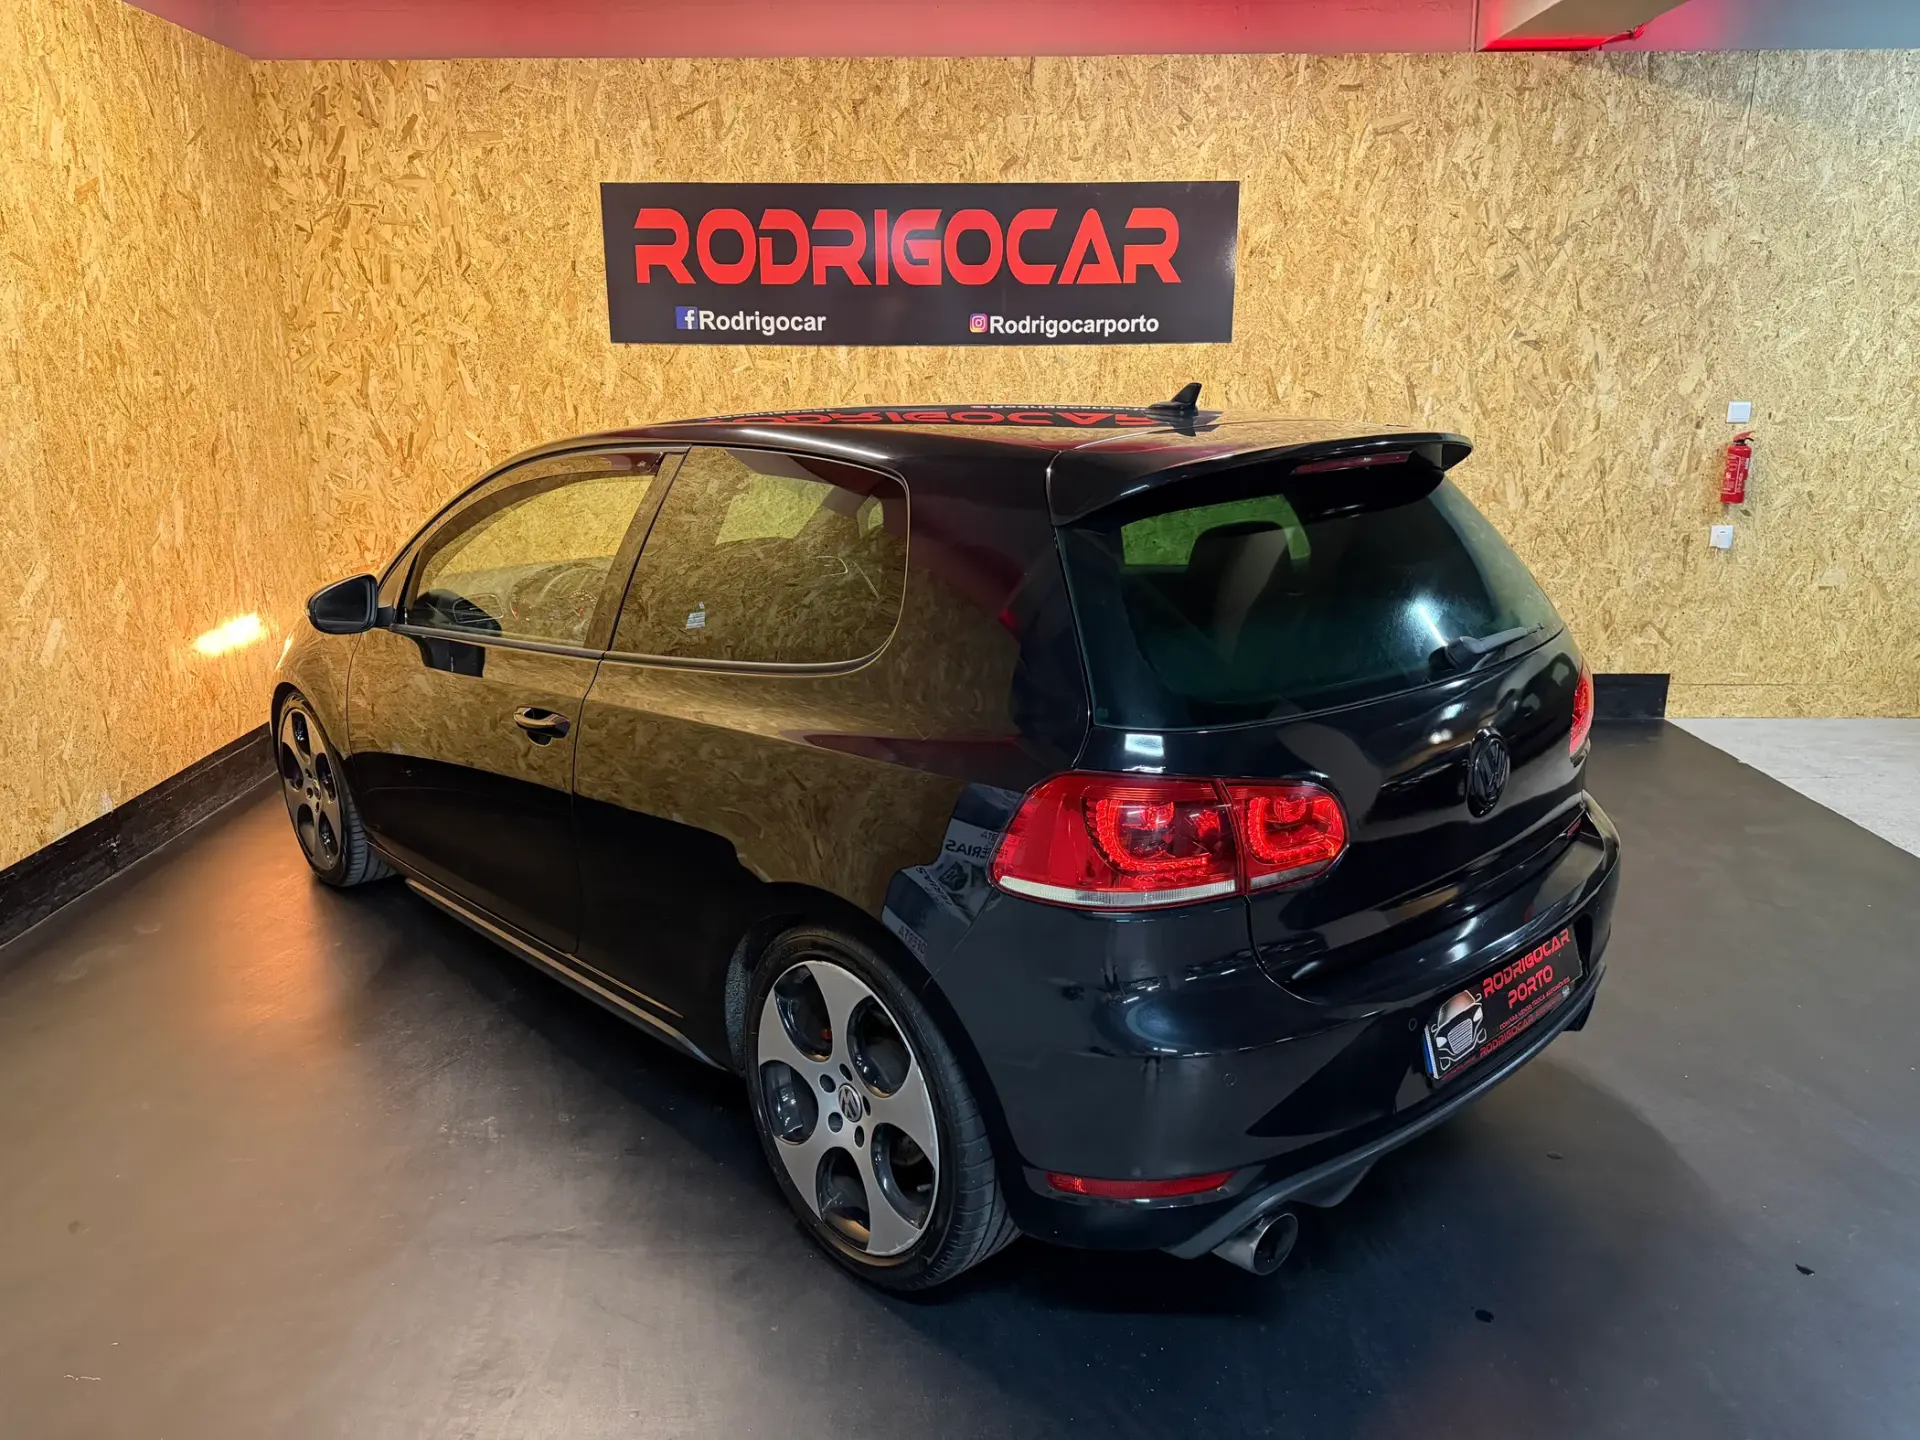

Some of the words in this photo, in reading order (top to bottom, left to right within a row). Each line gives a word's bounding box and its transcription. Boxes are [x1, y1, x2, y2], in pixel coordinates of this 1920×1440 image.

[633, 207, 1182, 286] RODRIGOCAR
[698, 310, 827, 336] Rodrigocar
[989, 314, 1160, 338] Rodrigocarporto
[1483, 928, 1571, 998] RODRIGOCAR
[1508, 965, 1553, 1009] PORTO
